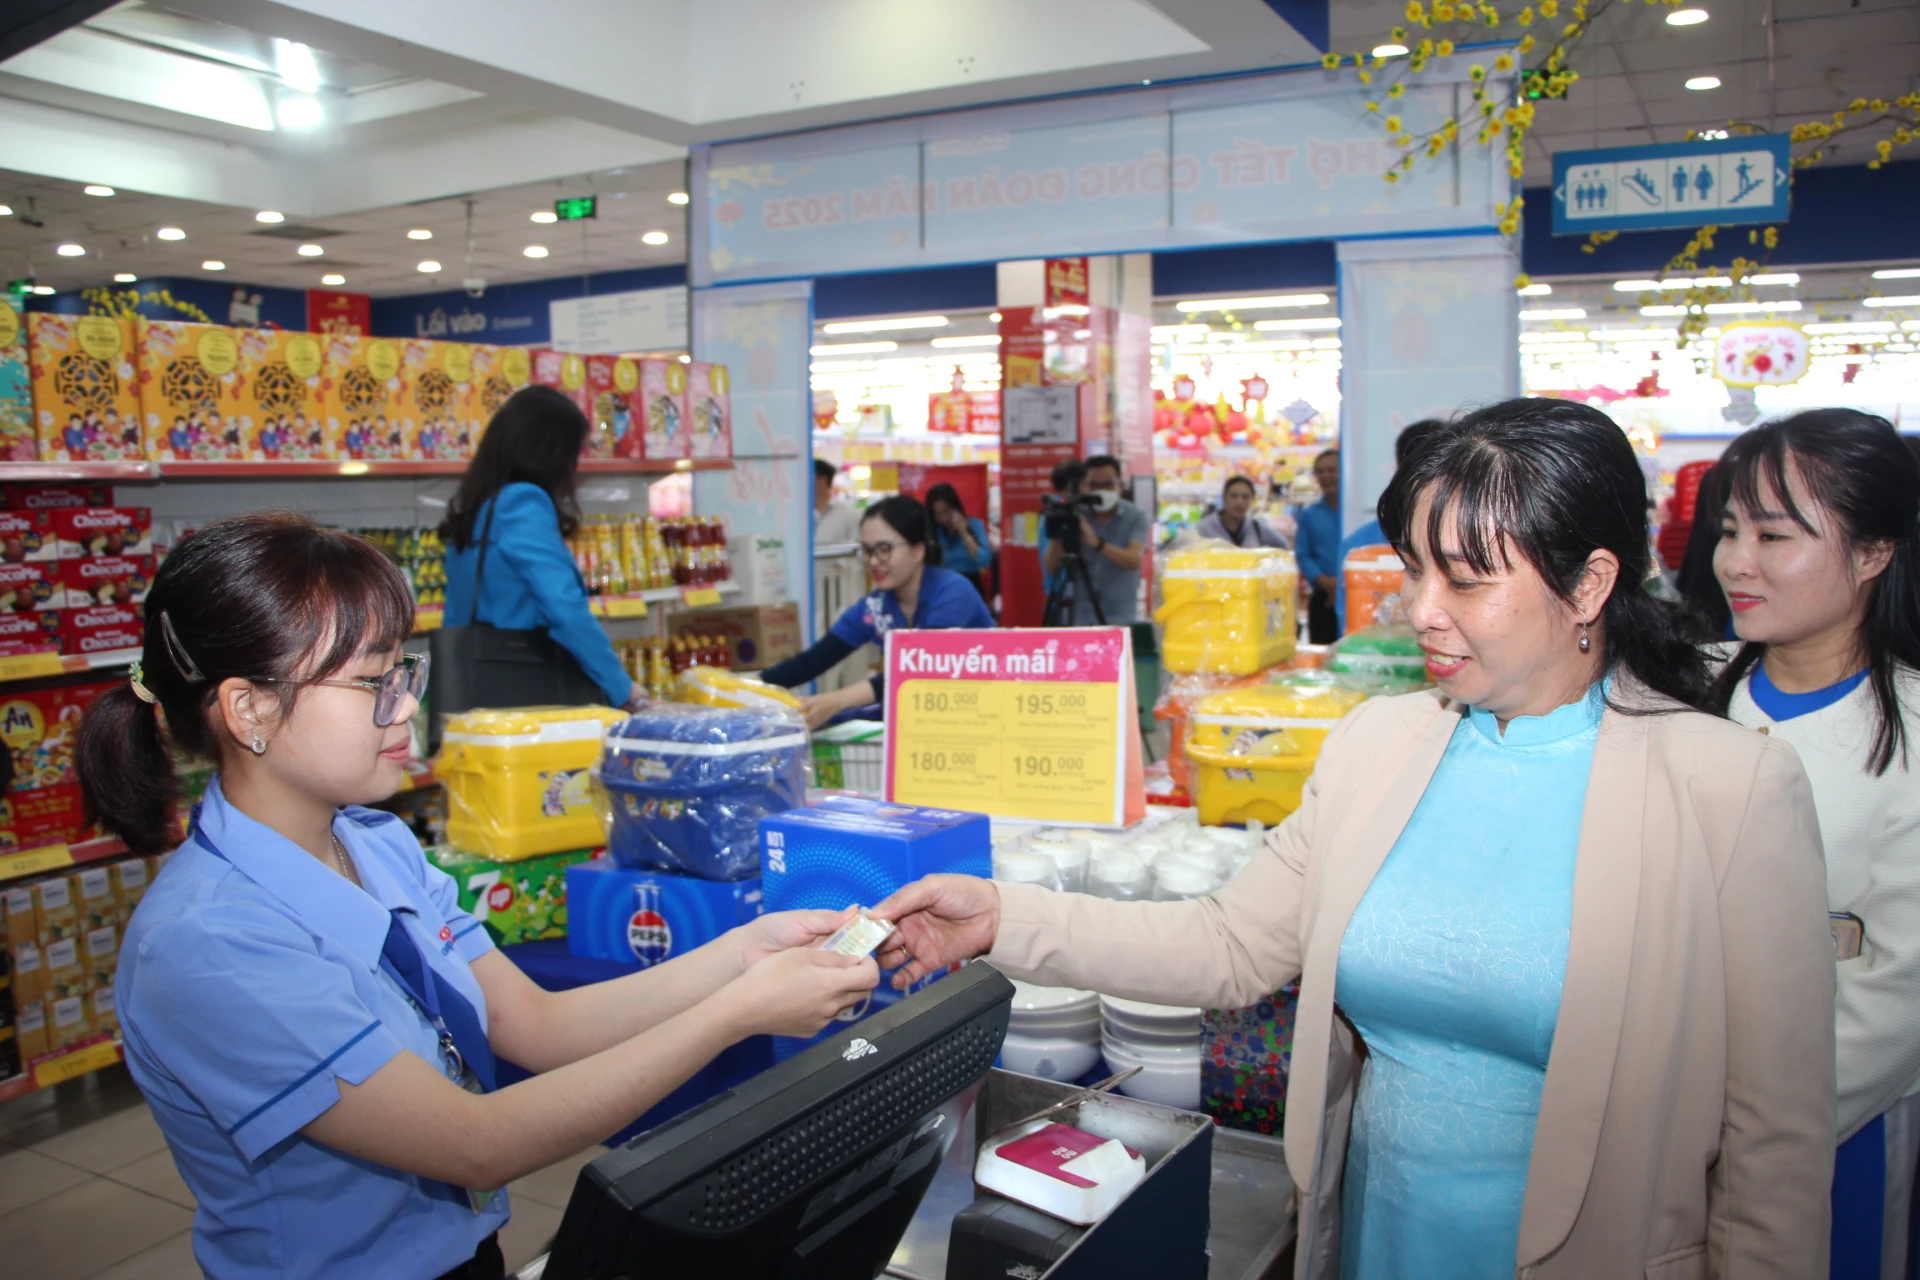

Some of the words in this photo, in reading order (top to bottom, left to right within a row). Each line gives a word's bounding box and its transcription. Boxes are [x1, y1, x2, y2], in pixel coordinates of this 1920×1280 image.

[899, 644, 998, 679] Khuyến
[1006, 649, 1056, 673] mãi
[631, 929, 668, 944] PEPSI
